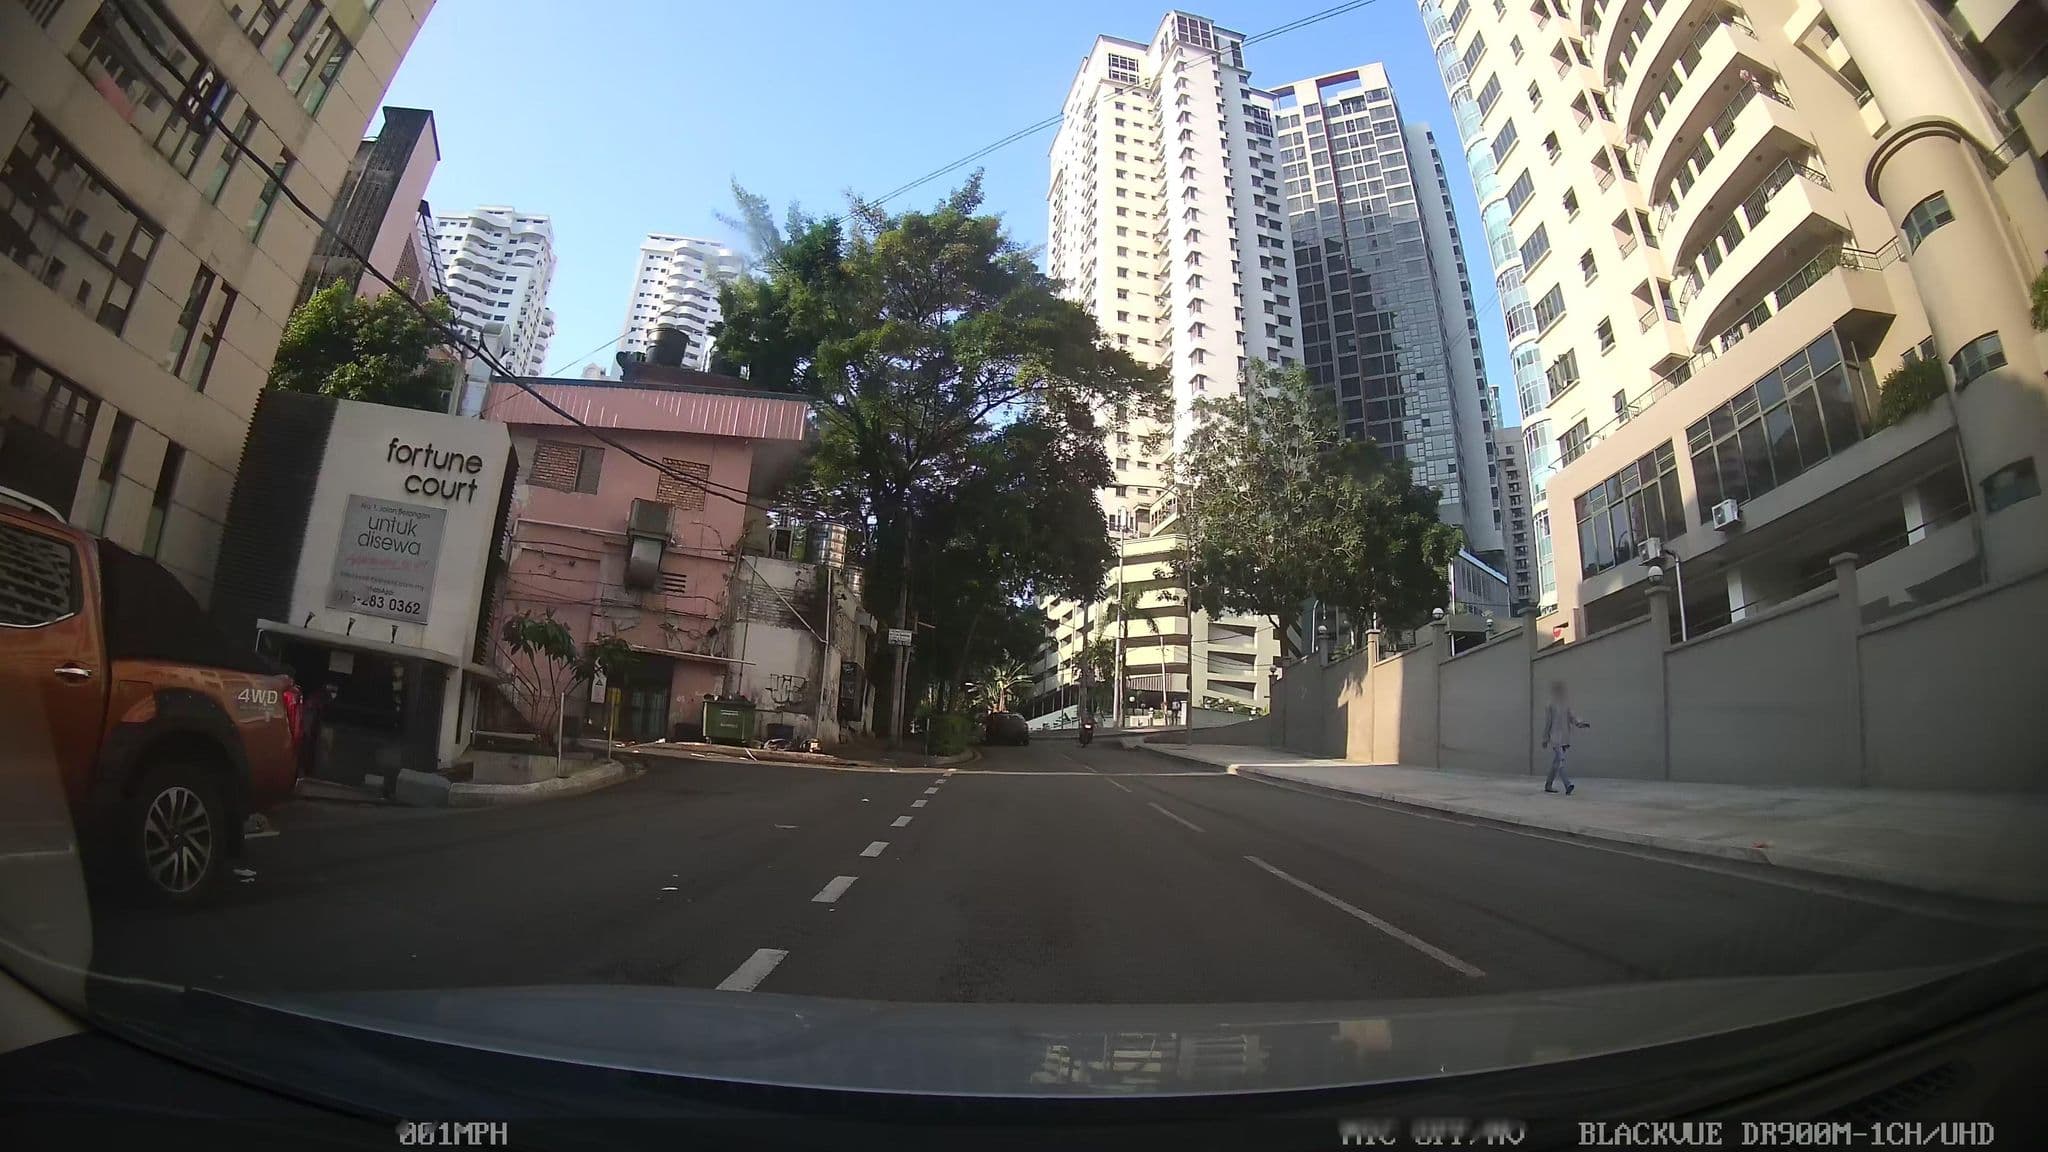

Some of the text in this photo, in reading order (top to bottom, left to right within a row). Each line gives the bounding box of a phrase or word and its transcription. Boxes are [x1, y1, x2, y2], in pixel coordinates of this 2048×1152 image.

[387, 437, 483, 474] fortune
[404, 474, 478, 504] court
[368, 515, 418, 537] untuk
[357, 531, 422, 555] disewa
[389, 598, 421, 615] 0362
[238, 688, 278, 704] 4WD
